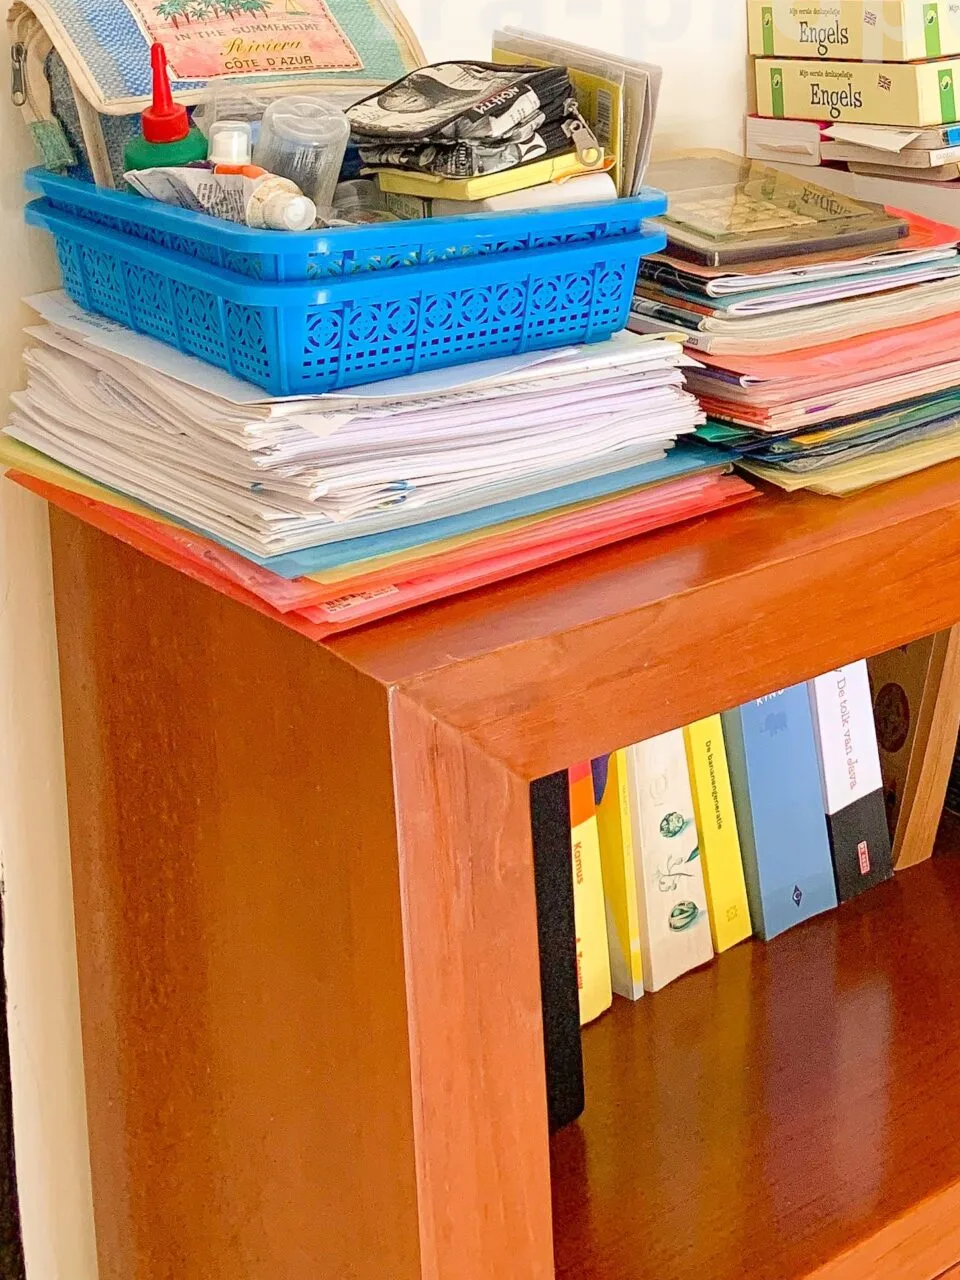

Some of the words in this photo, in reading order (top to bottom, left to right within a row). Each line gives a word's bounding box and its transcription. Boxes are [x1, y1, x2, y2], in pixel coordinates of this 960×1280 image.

[197, 29, 225, 39] THE
[231, 22, 321, 35] SUMMERTIME
[800, 19, 849, 56] Engels
[220, 37, 301, 56] Riviera
[225, 57, 262, 70] CÔTE
[810, 83, 863, 119] Engels
[837, 677, 846, 697] De
[840, 700, 850, 727] tolk
[844, 729, 853, 755] van
[847, 758, 858, 790] Java
[573, 841, 584, 885] Kamus
